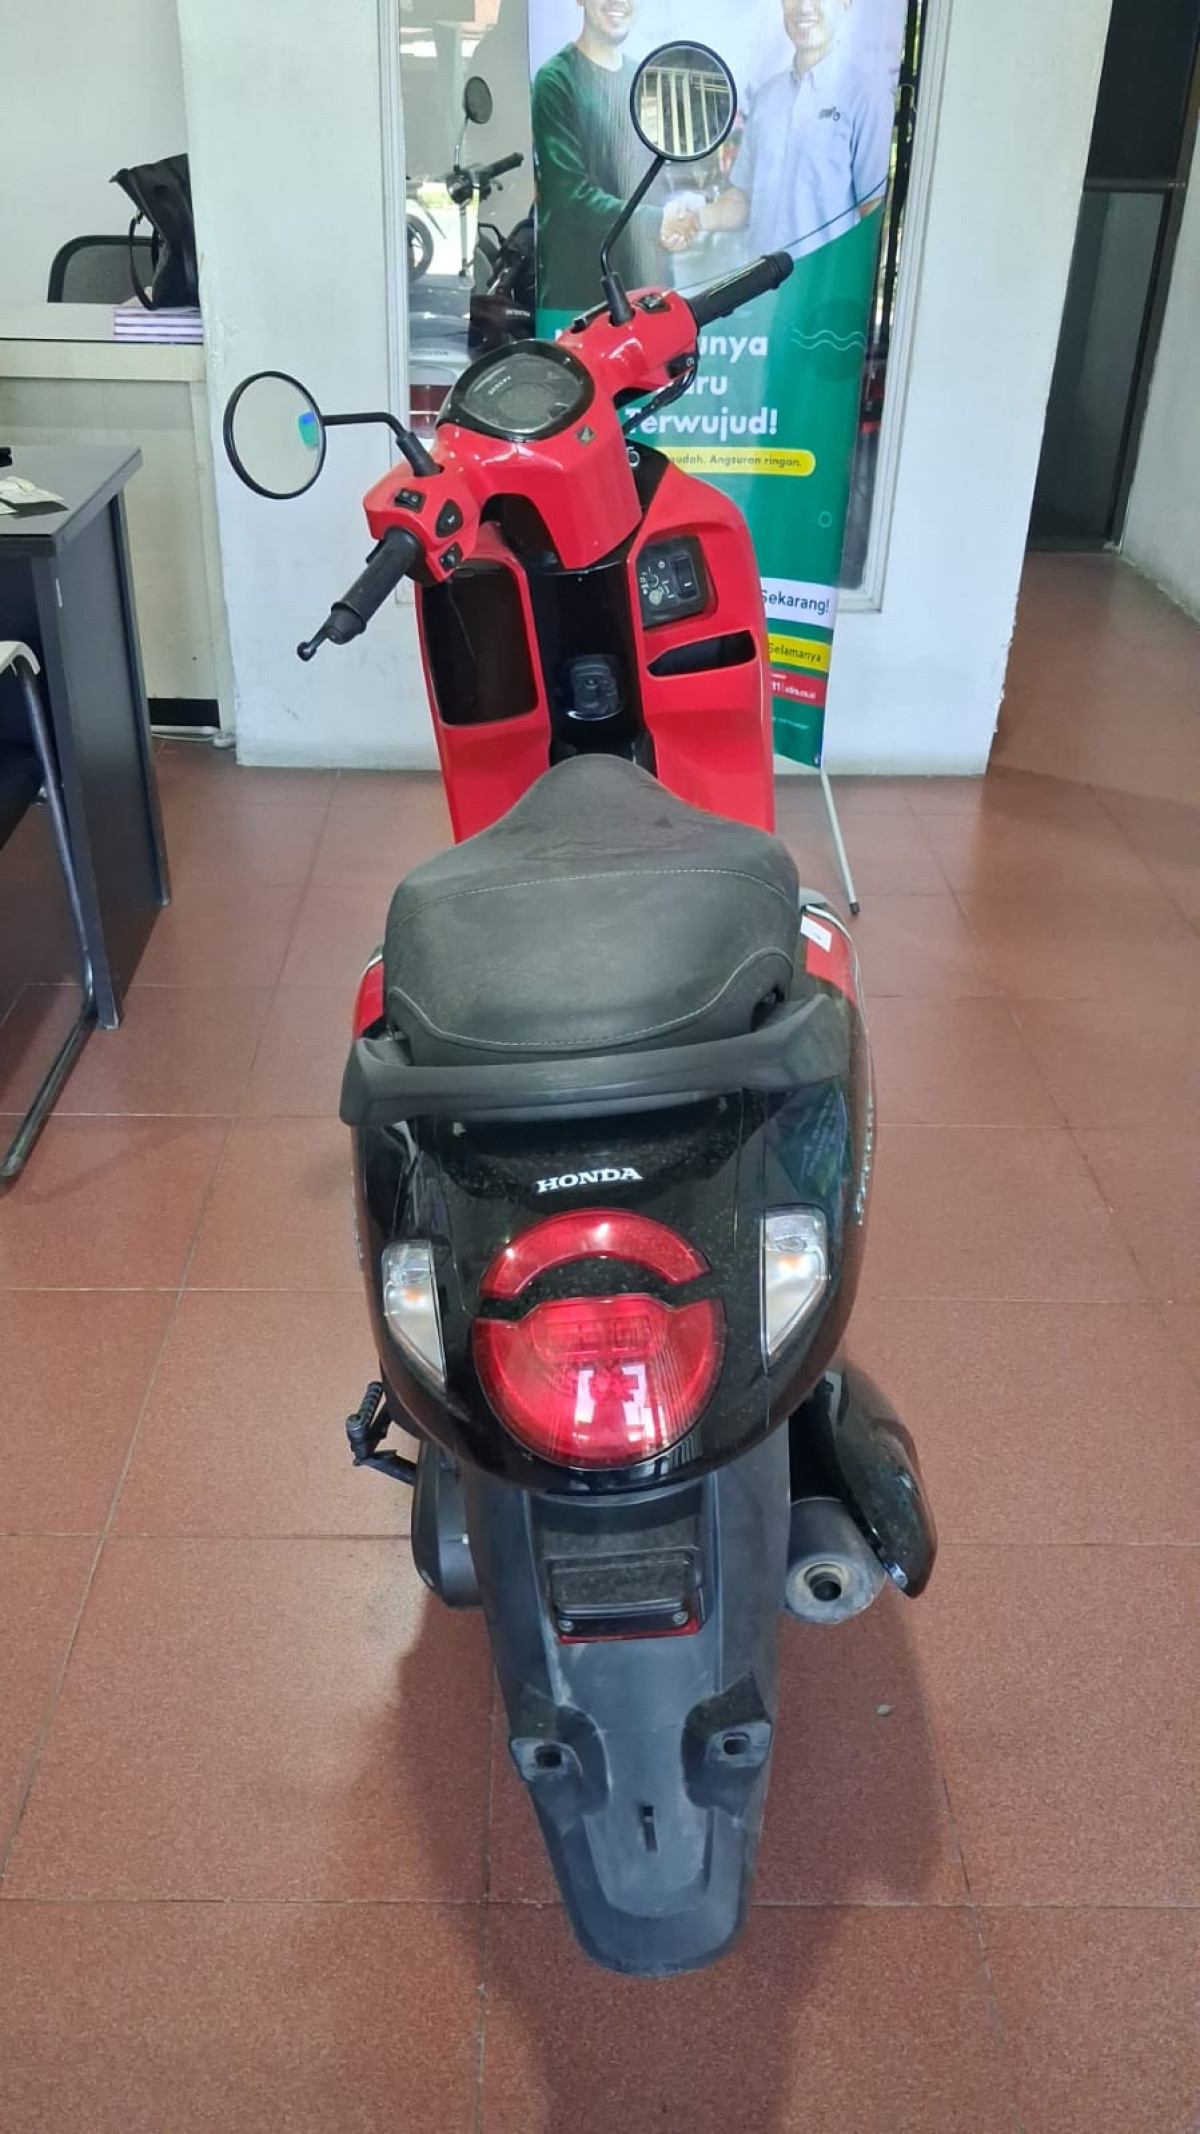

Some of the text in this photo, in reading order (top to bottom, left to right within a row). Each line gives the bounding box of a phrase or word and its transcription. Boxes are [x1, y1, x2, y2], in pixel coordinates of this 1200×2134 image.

[764, 456, 802, 468] ringan.
[761, 589, 830, 616] Sekarang!
[768, 643, 823, 665] Selamanya
[536, 1167, 643, 1194] HONDA
